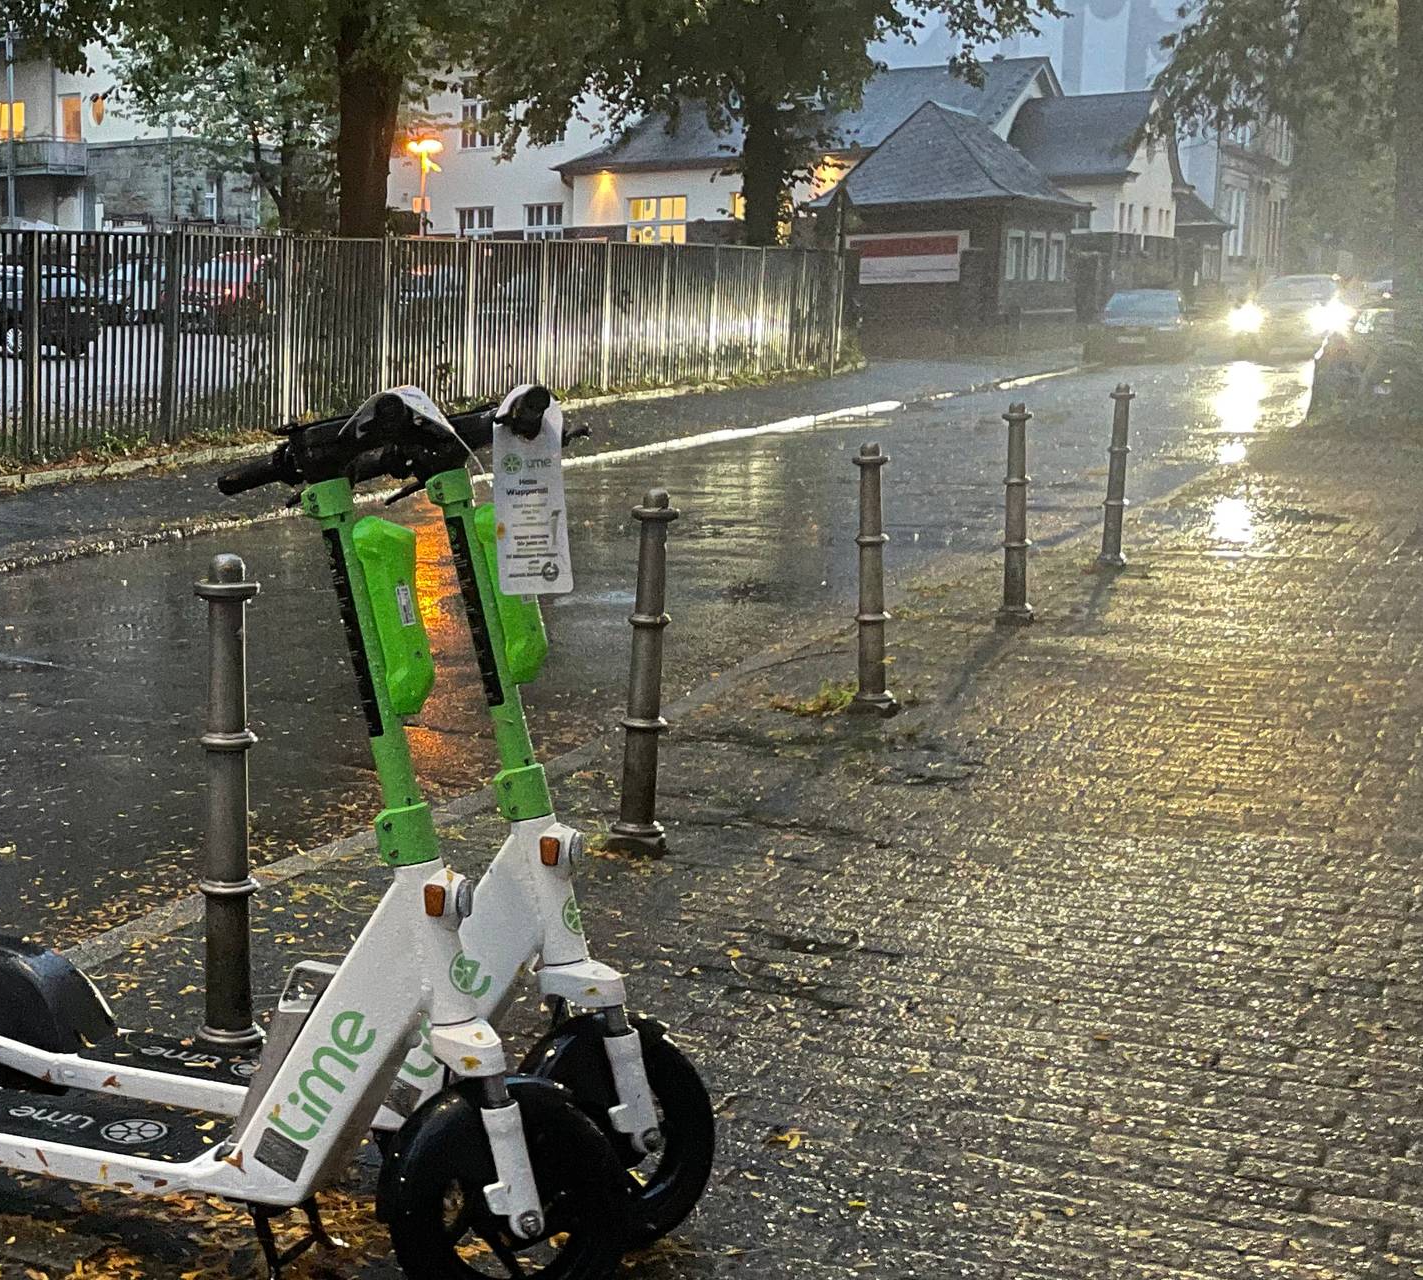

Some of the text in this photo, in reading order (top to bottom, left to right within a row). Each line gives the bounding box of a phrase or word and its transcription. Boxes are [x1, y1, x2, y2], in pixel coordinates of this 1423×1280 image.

[139, 1044, 223, 1069] Lime
[267, 1010, 377, 1142] Lime
[7, 1104, 96, 1130] Lime
